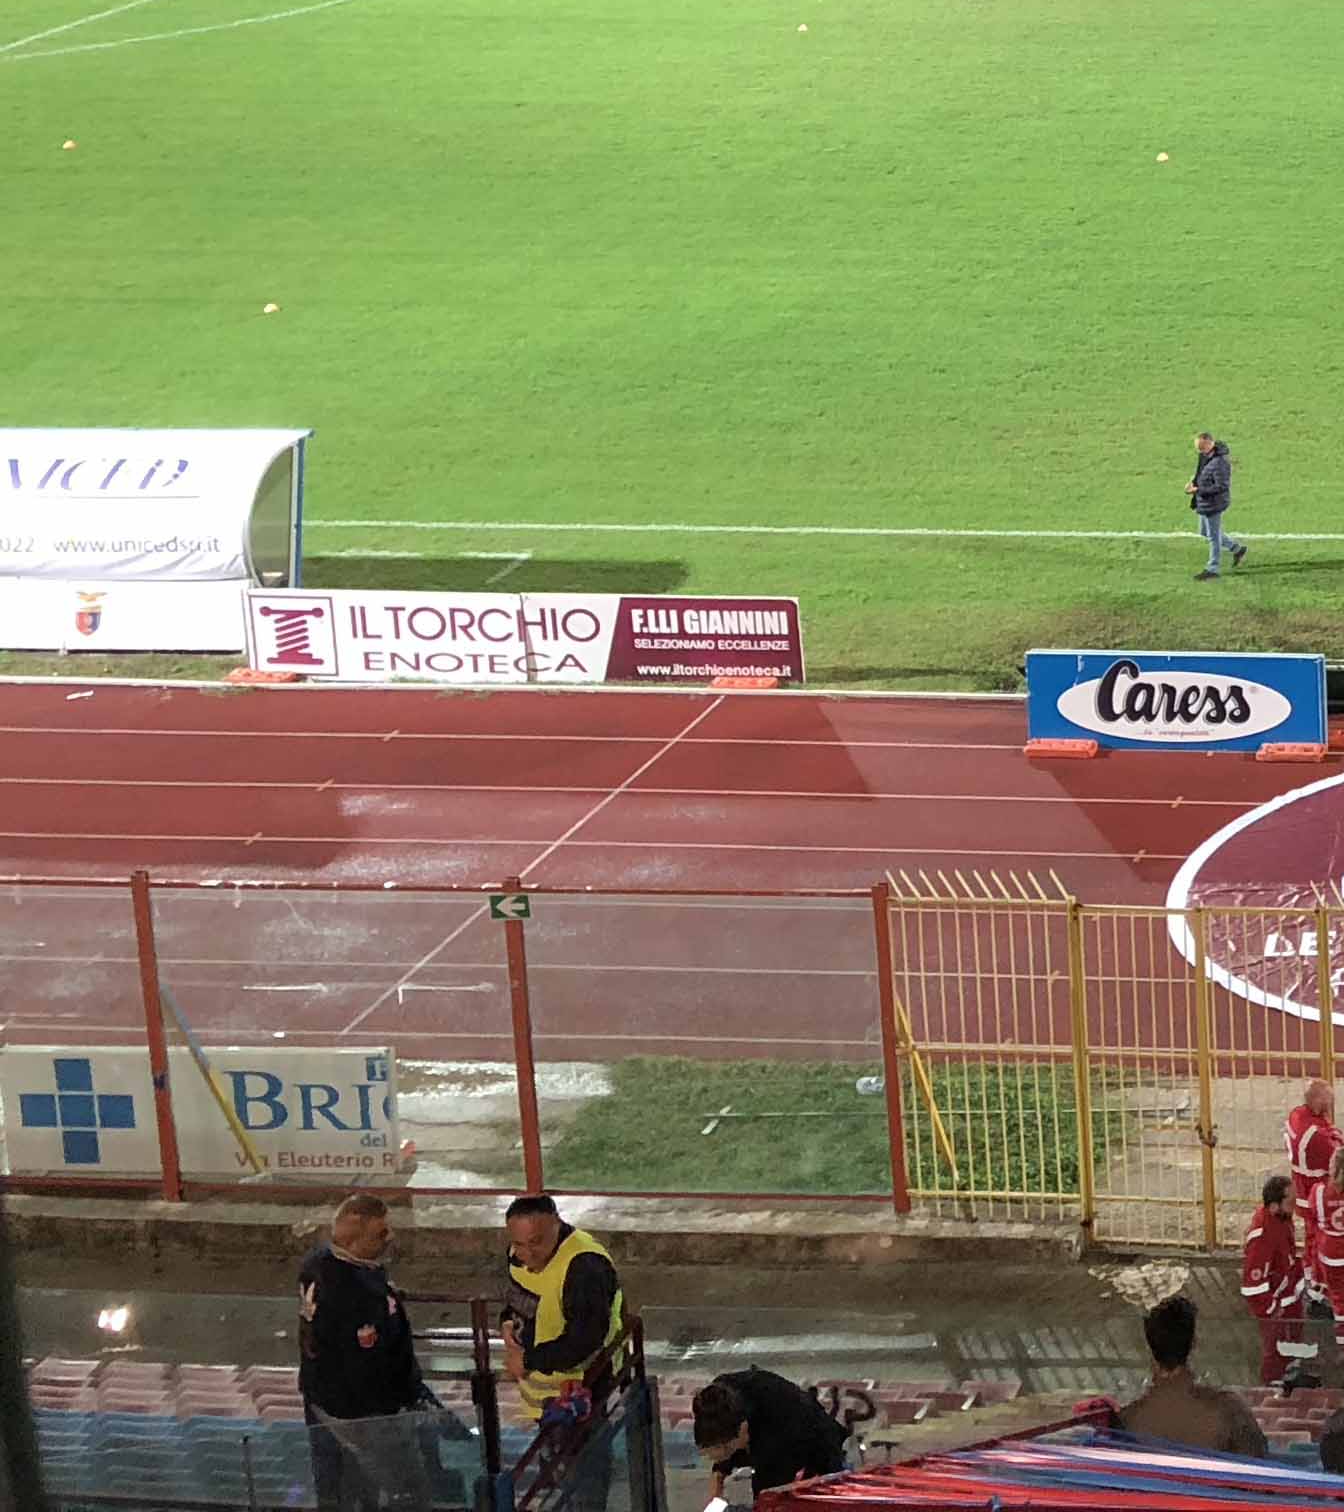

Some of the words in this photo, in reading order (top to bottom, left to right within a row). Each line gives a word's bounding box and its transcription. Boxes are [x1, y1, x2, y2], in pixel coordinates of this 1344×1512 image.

[349, 605, 383, 640] IL
[384, 605, 601, 643] TORCHIO
[631, 608, 680, 635] F.LLI
[683, 609, 790, 636] GIANNINI
[634, 638, 715, 651] SELEZIONIAMO
[717, 639, 791, 651] ECCELLENZE
[362, 651, 589, 674] ENOTECA
[636, 663, 792, 678] www.iltorchioenoteca.it
[1096, 658, 1252, 725] Caress
[276, 1151, 374, 1169] Eleuterio
